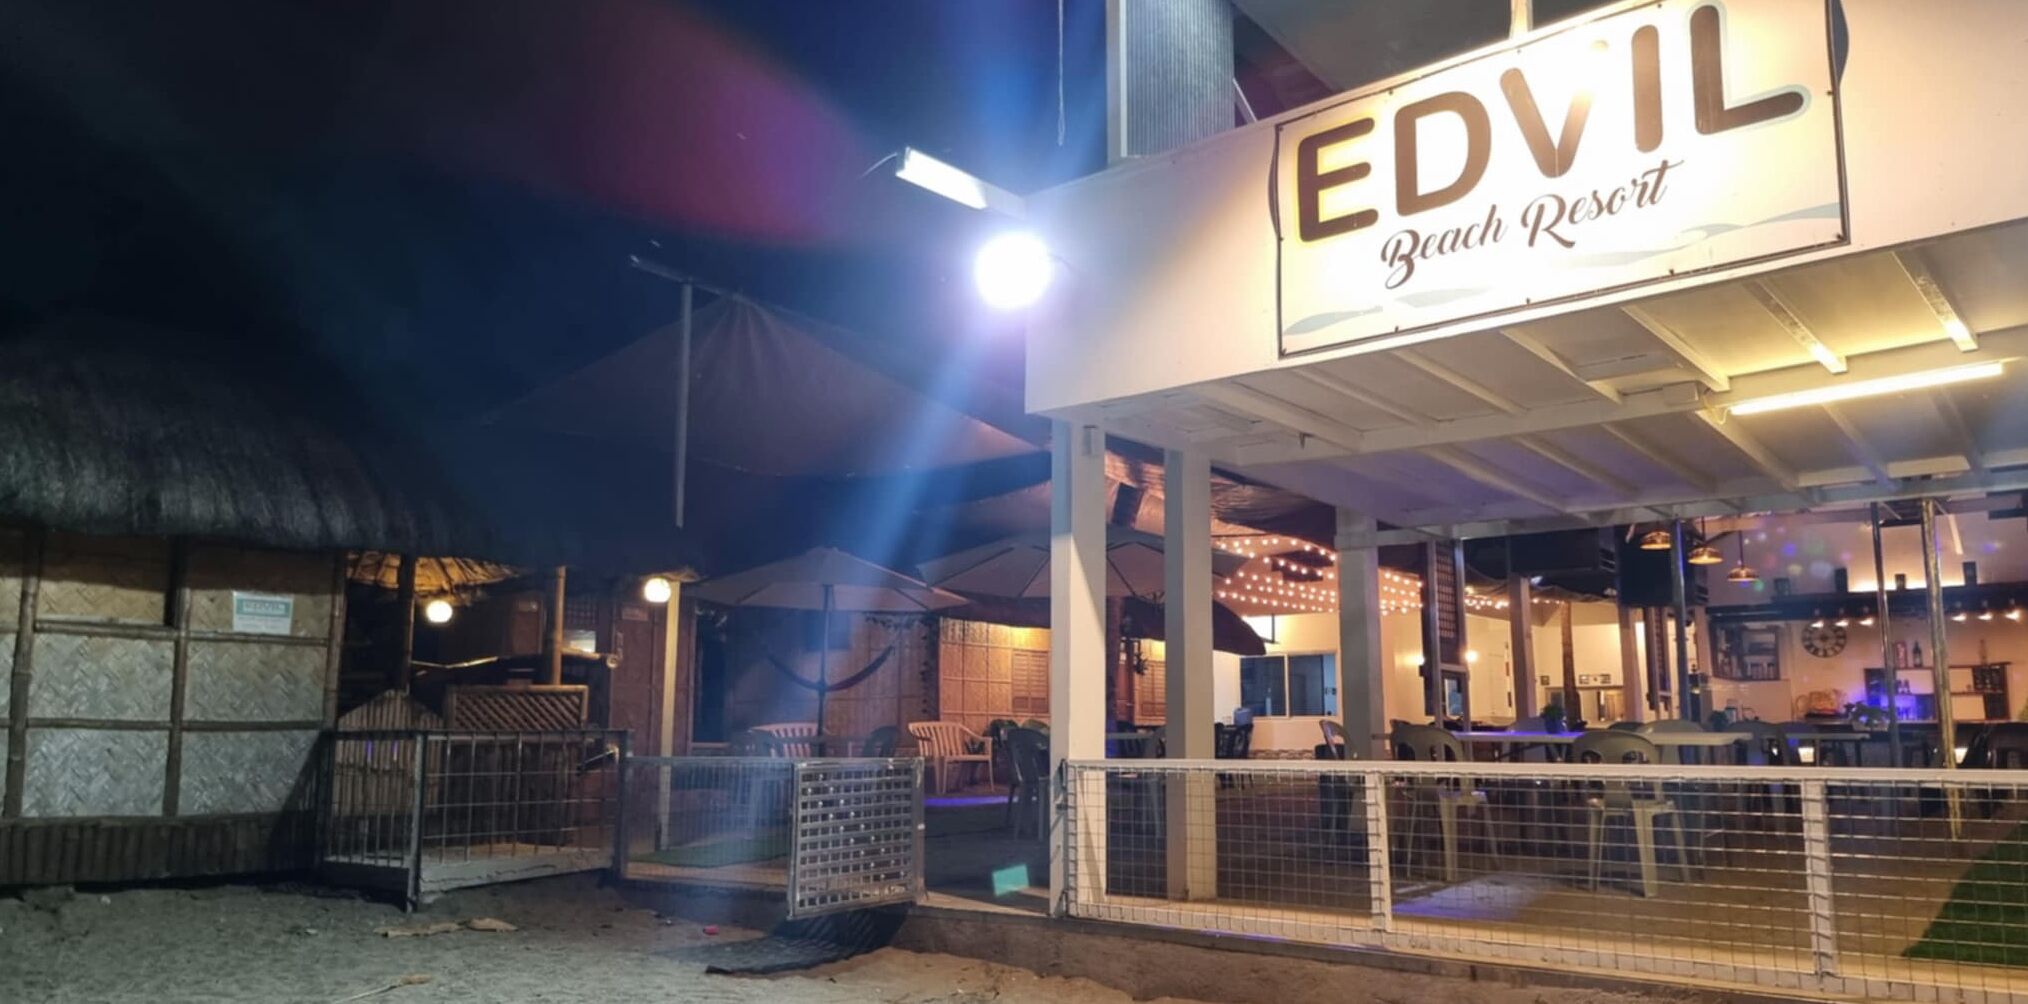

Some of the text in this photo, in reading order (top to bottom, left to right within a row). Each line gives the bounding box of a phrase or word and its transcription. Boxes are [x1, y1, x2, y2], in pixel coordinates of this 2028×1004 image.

[1297, 4, 1805, 243] EDVIL
[1380, 159, 1685, 290] Beach Resort
